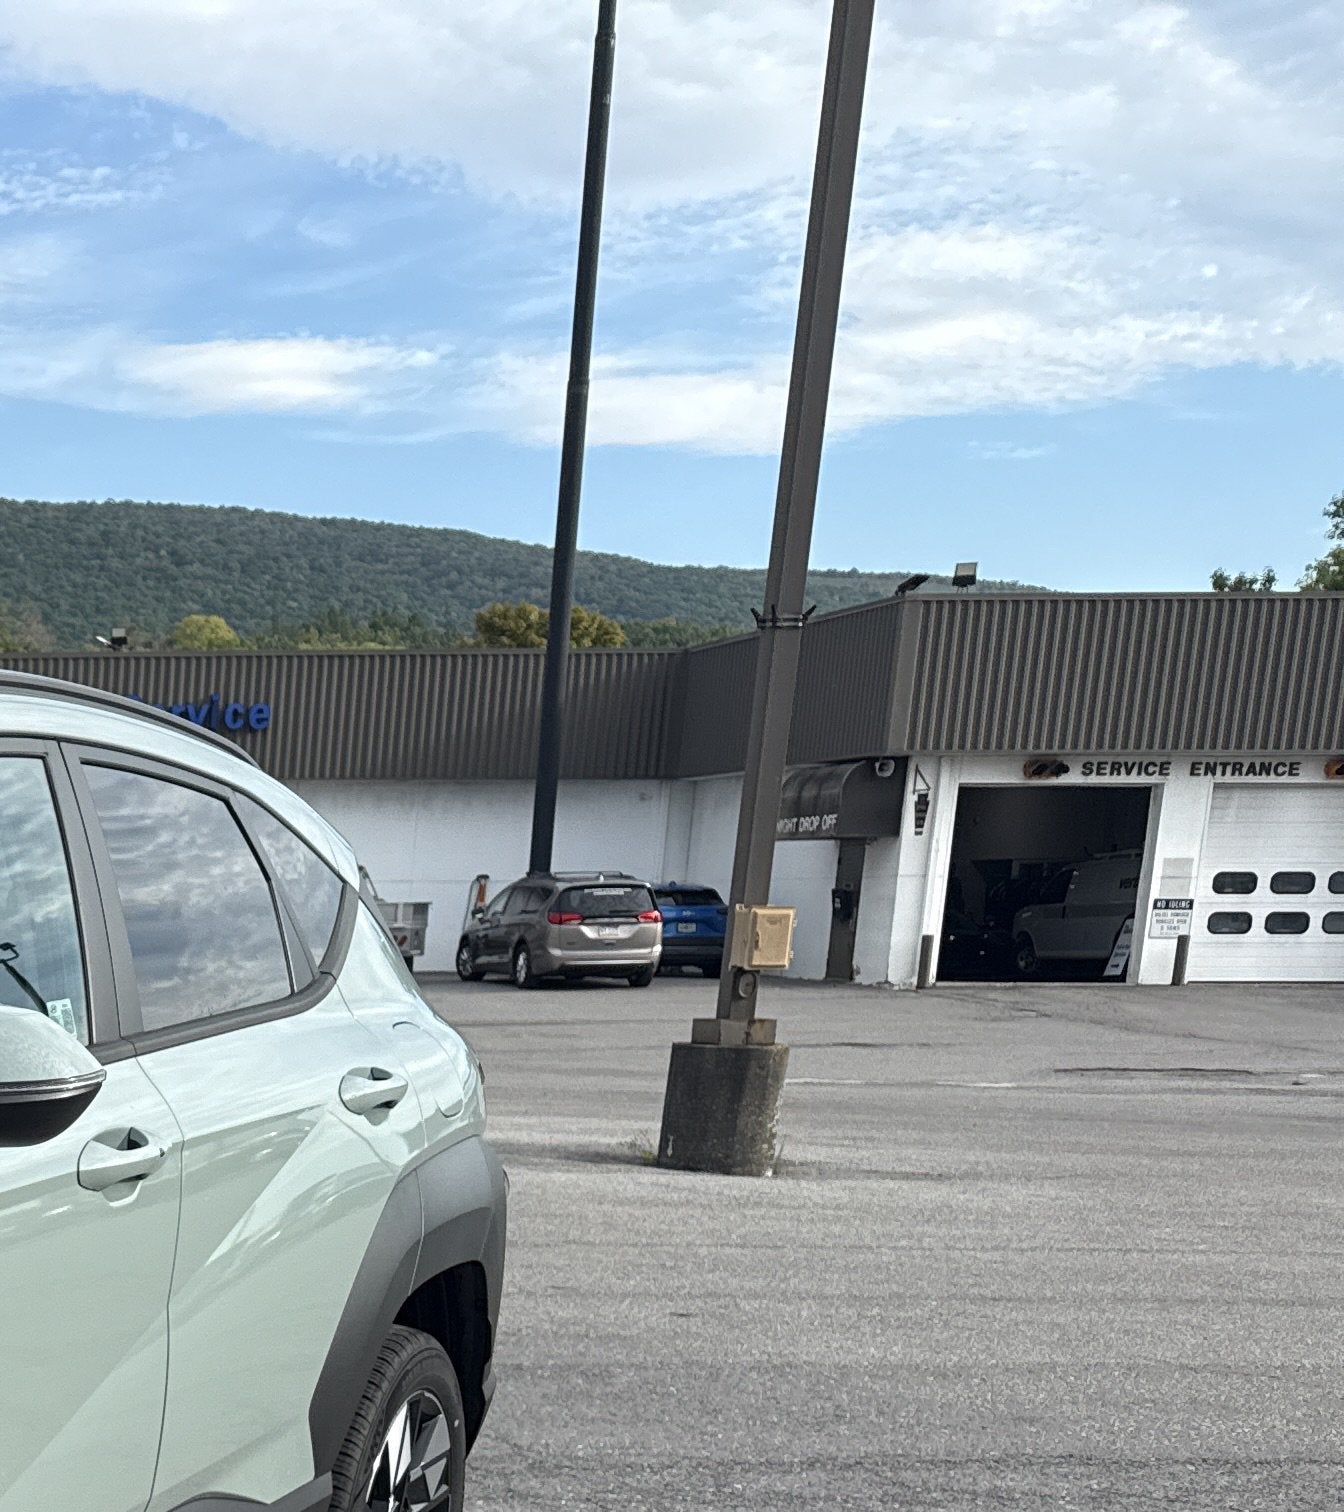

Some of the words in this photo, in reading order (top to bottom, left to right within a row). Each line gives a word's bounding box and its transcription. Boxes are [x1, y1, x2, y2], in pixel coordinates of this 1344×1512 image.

[129, 692, 272, 730] rvice
[1081, 761, 1171, 777] SERVICE
[1189, 761, 1301, 777] ENTRANCE
[799, 815, 821, 832] DROP
[822, 813, 838, 831] OFF
